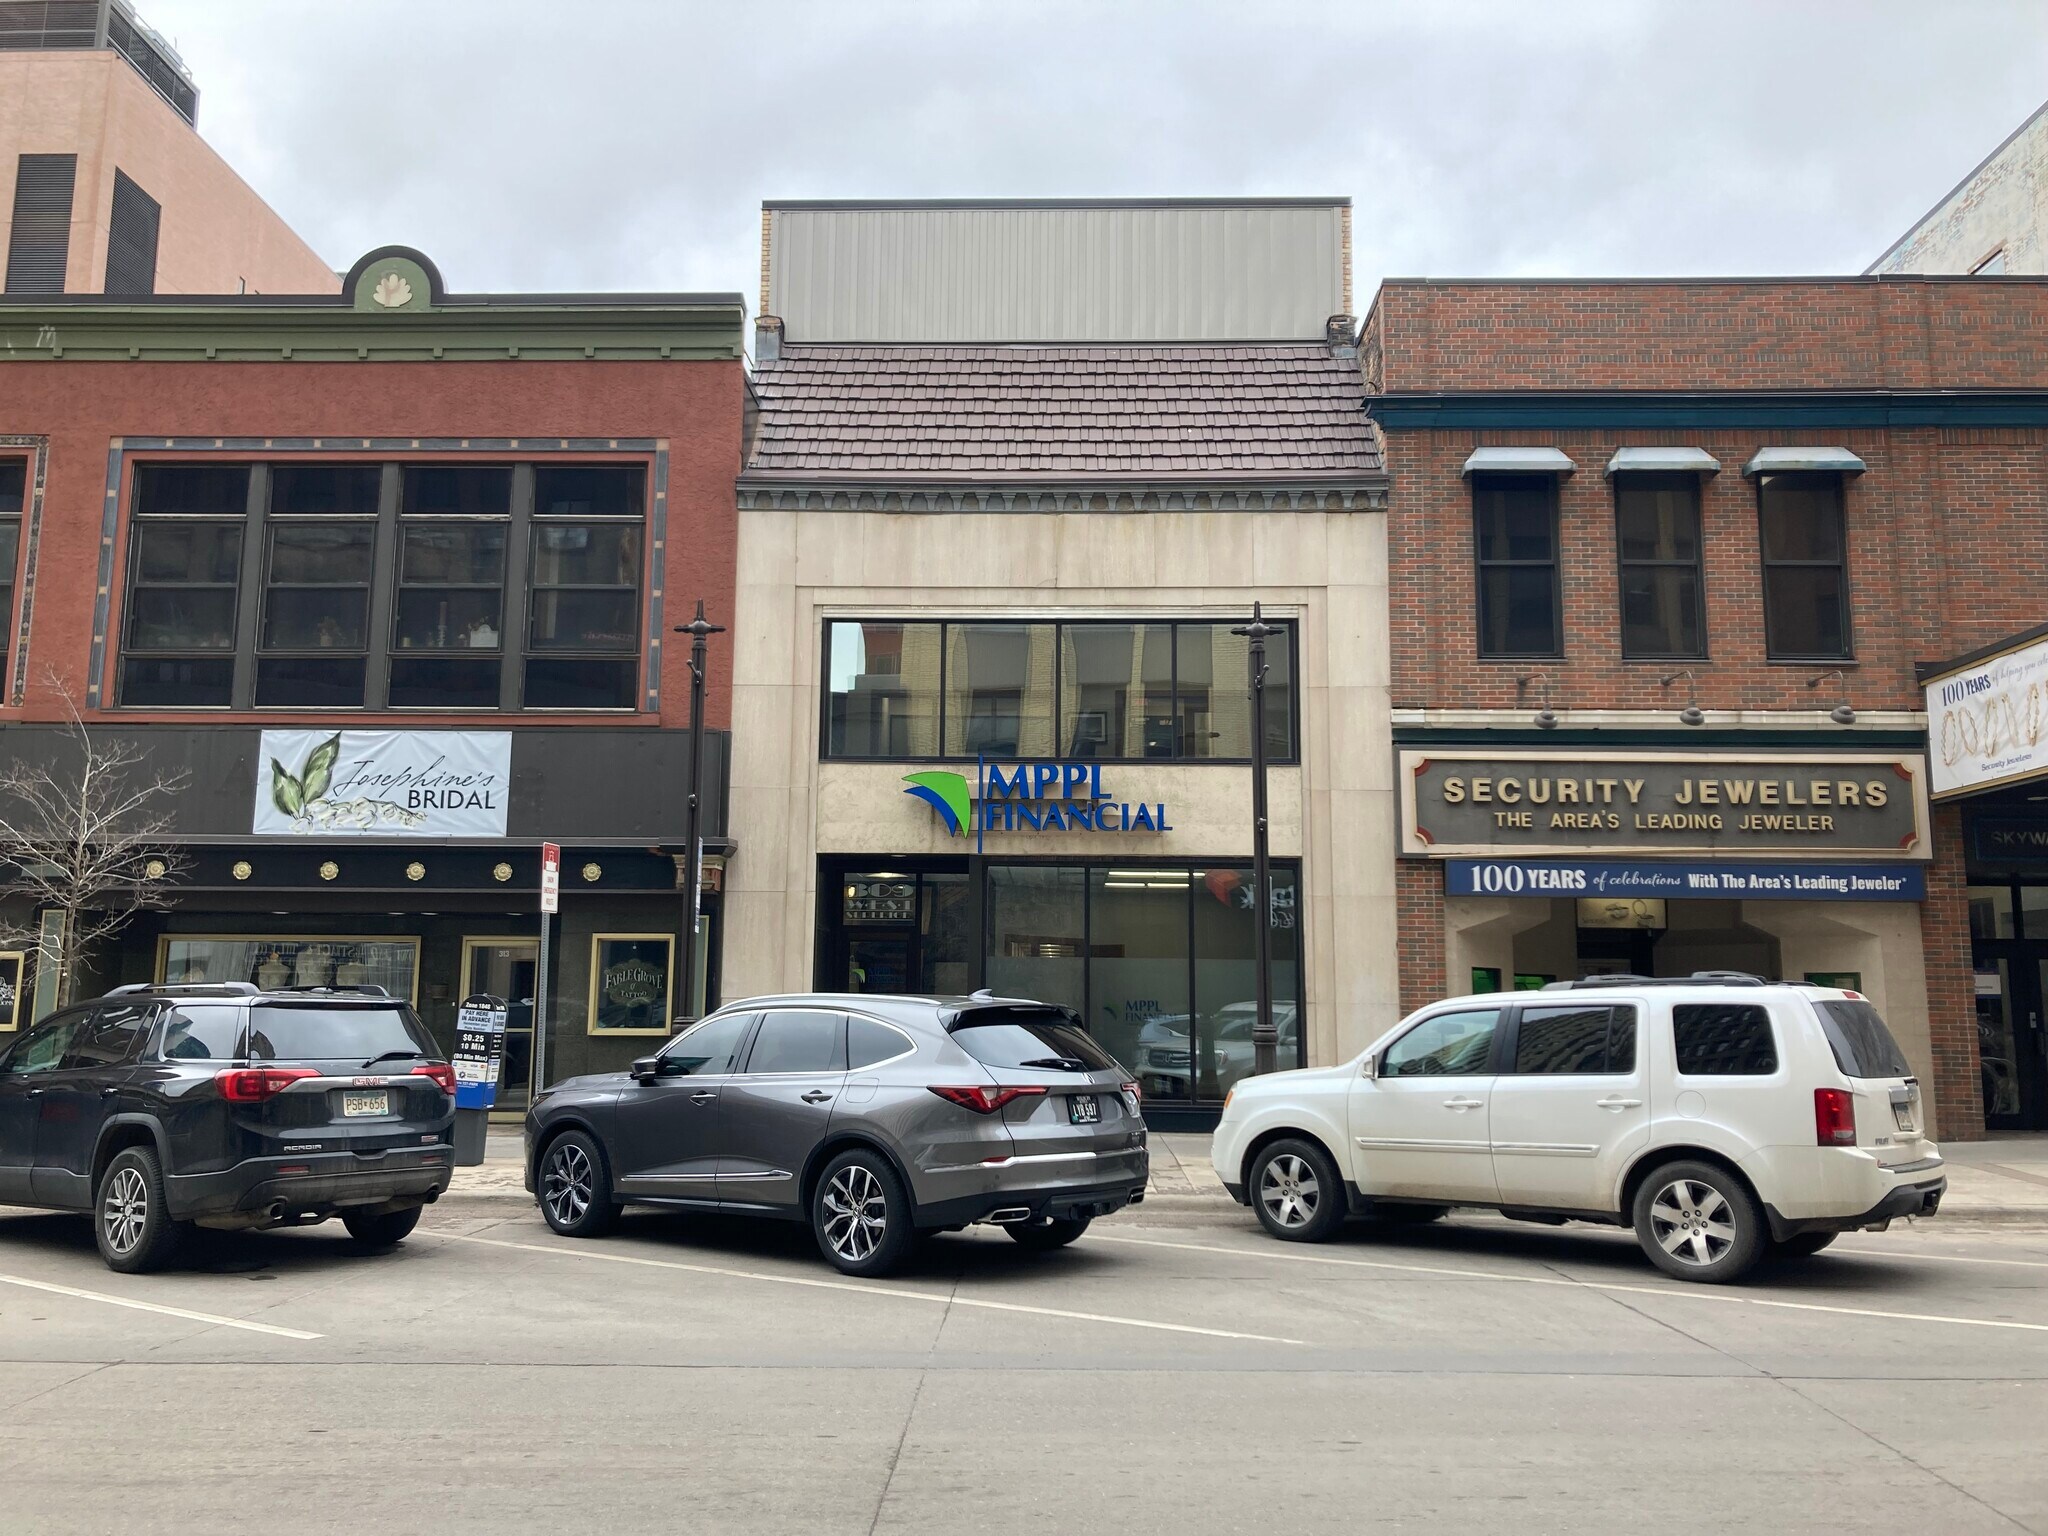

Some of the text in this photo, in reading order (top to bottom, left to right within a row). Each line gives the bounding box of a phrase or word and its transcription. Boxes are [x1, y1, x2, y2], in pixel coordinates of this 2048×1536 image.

[1942, 680, 1965, 706] 100
[1965, 674, 1992, 696] YEARS
[333, 755, 495, 798] Josephine's
[986, 764, 1112, 800] MPPL
[408, 789, 496, 809] BRIDAL
[1443, 776, 1888, 808] SECURITY JEWELERS
[985, 802, 1173, 832] FINANCIAL
[1494, 809, 1835, 832] THE AREA'S LEADING JEWELER
[1990, 830, 2048, 846] SKYW
[1470, 864, 1524, 893] 100
[1526, 868, 1587, 890] YEARS
[1592, 870, 1608, 892] of
[1609, 870, 1682, 887] celebrations
[1687, 873, 1719, 889] With
[1720, 873, 1746, 889] The
[1749, 873, 1792, 890] Area's
[1793, 874, 1849, 893] Leading
[498, 950, 510, 958] 313
[620, 990, 648, 999] TATTOO
[1124, 999, 1163, 1013] MPPL
[463, 1034, 485, 1043] $0.25
[470, 1042, 486, 1051] Min
[463, 1053, 474, 1061] Min
[352, 1077, 390, 1086] GMC
